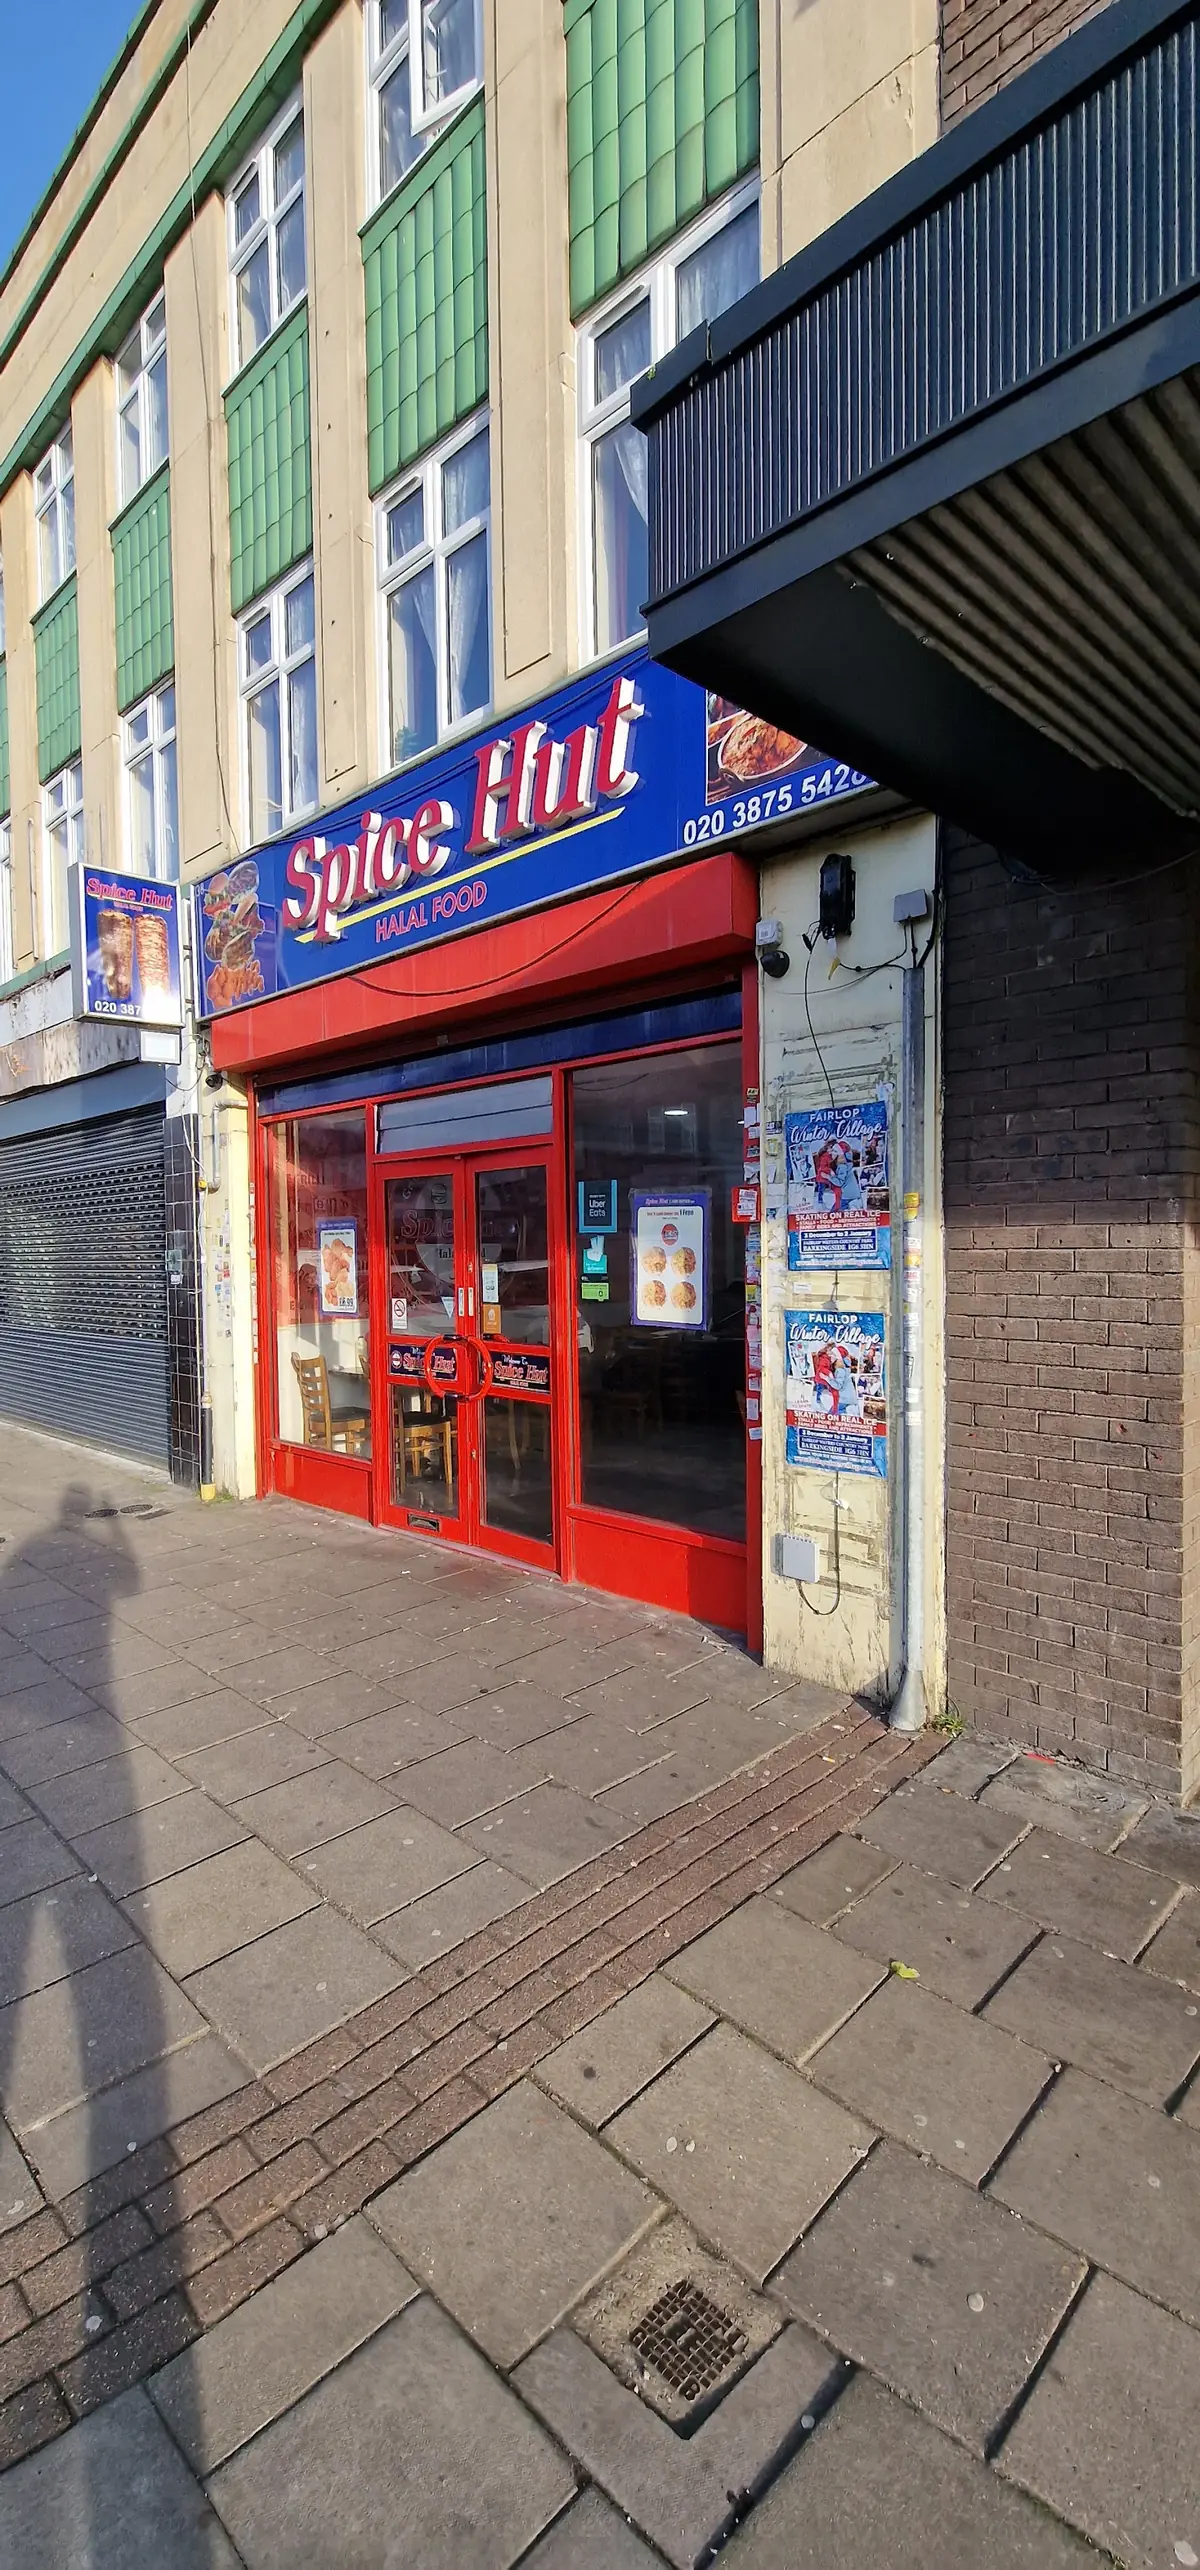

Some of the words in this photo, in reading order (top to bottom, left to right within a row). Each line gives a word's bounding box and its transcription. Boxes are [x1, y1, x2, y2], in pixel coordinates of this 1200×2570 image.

[283, 799, 453, 942] Spice
[464, 677, 644, 852] Hut
[683, 809, 725, 845] 020
[733, 784, 793, 828] 3875
[86, 878, 137, 900] Spice
[141, 888, 173, 909] Hut
[376, 908, 428, 943] HALAL
[432, 881, 487, 922] FOOD
[94, 1000, 117, 1013] 020
[120, 1003, 141, 1016] 387
[809, 1108, 860, 1123] FAIRLOP
[789, 1125, 831, 1143] Winter
[834, 1119, 883, 1140] Village
[589, 1199, 606, 1208] Uber
[589, 1209, 606, 1217] Eats
[795, 1213, 828, 1222] SKATING
[843, 1211, 865, 1219] REAL
[809, 1313, 858, 1324] FAIRLOP
[789, 1323, 831, 1341] Winter
[834, 1324, 881, 1350] Village
[403, 1352, 428, 1371] Spic
[433, 1356, 455, 1371] Hut
[494, 1360, 524, 1381] Spice
[526, 1364, 549, 1383] Hut
[794, 1411, 825, 1420] SKATING
[827, 1413, 839, 1421] ON
[840, 1416, 862, 1425] REAL
[863, 1418, 877, 1426] ICE
[806, 1431, 833, 1439] December
[846, 1435, 868, 1444] January
[801, 1442, 843, 1454] BARKINGSIDE
